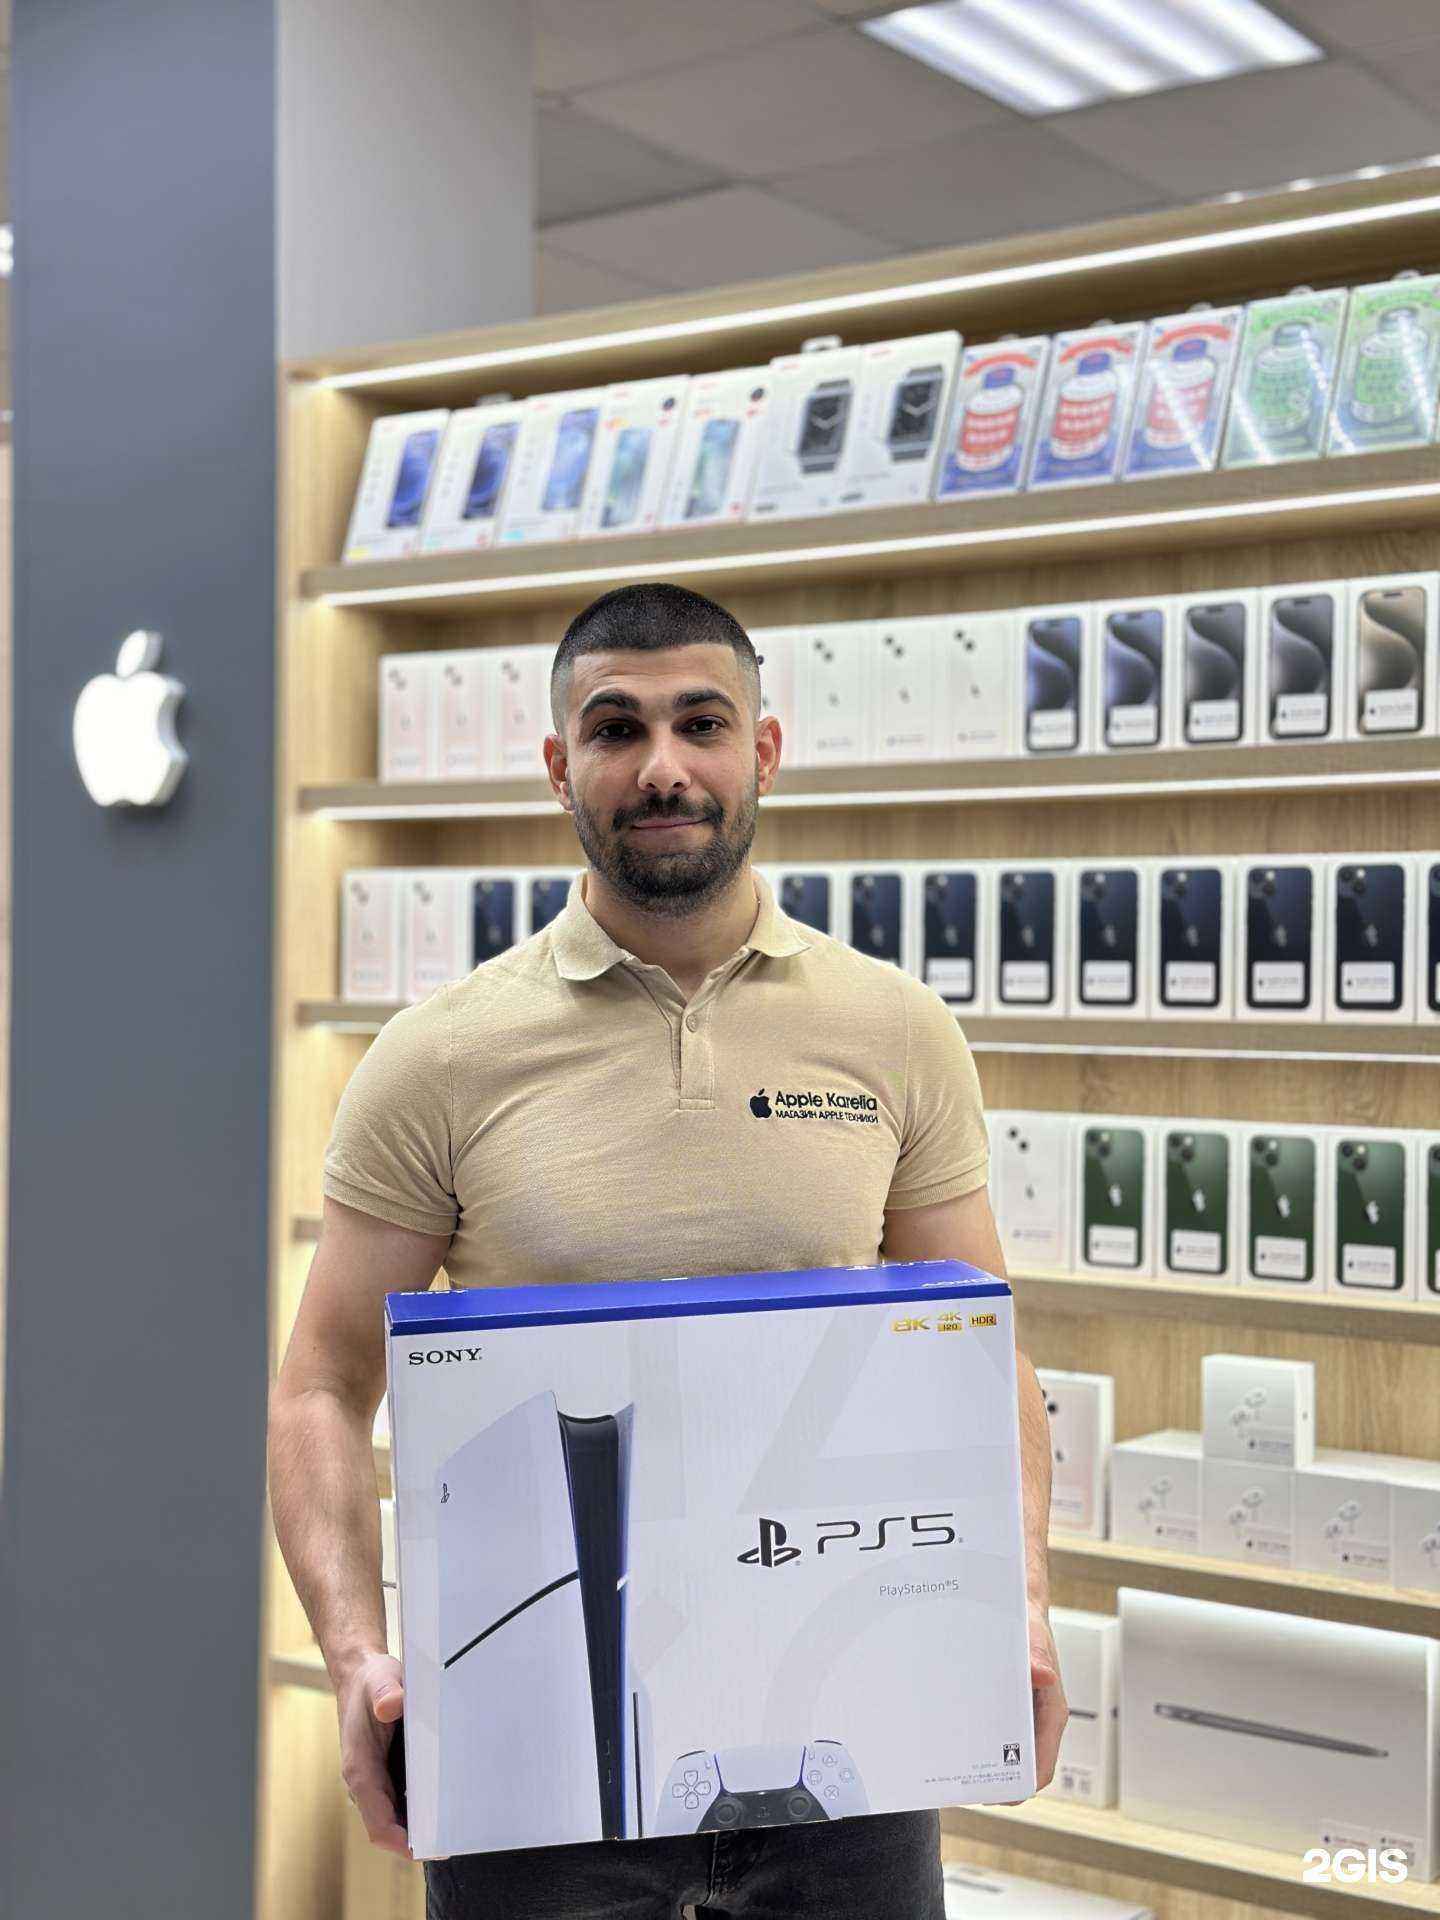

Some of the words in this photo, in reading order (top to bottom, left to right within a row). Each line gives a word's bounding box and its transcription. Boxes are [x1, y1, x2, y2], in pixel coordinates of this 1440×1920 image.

[775, 1090, 823, 1108] Apple
[826, 1092, 878, 1111] Karelia
[775, 1110, 817, 1120] МАГАЗИН
[818, 1111, 844, 1121] APPLE
[844, 1112, 879, 1124] ТЕХНИКИ
[894, 1316, 931, 1332] 8K
[971, 1315, 995, 1326] HDR
[408, 1348, 482, 1366] SONY
[816, 1513, 956, 1555] PS5
